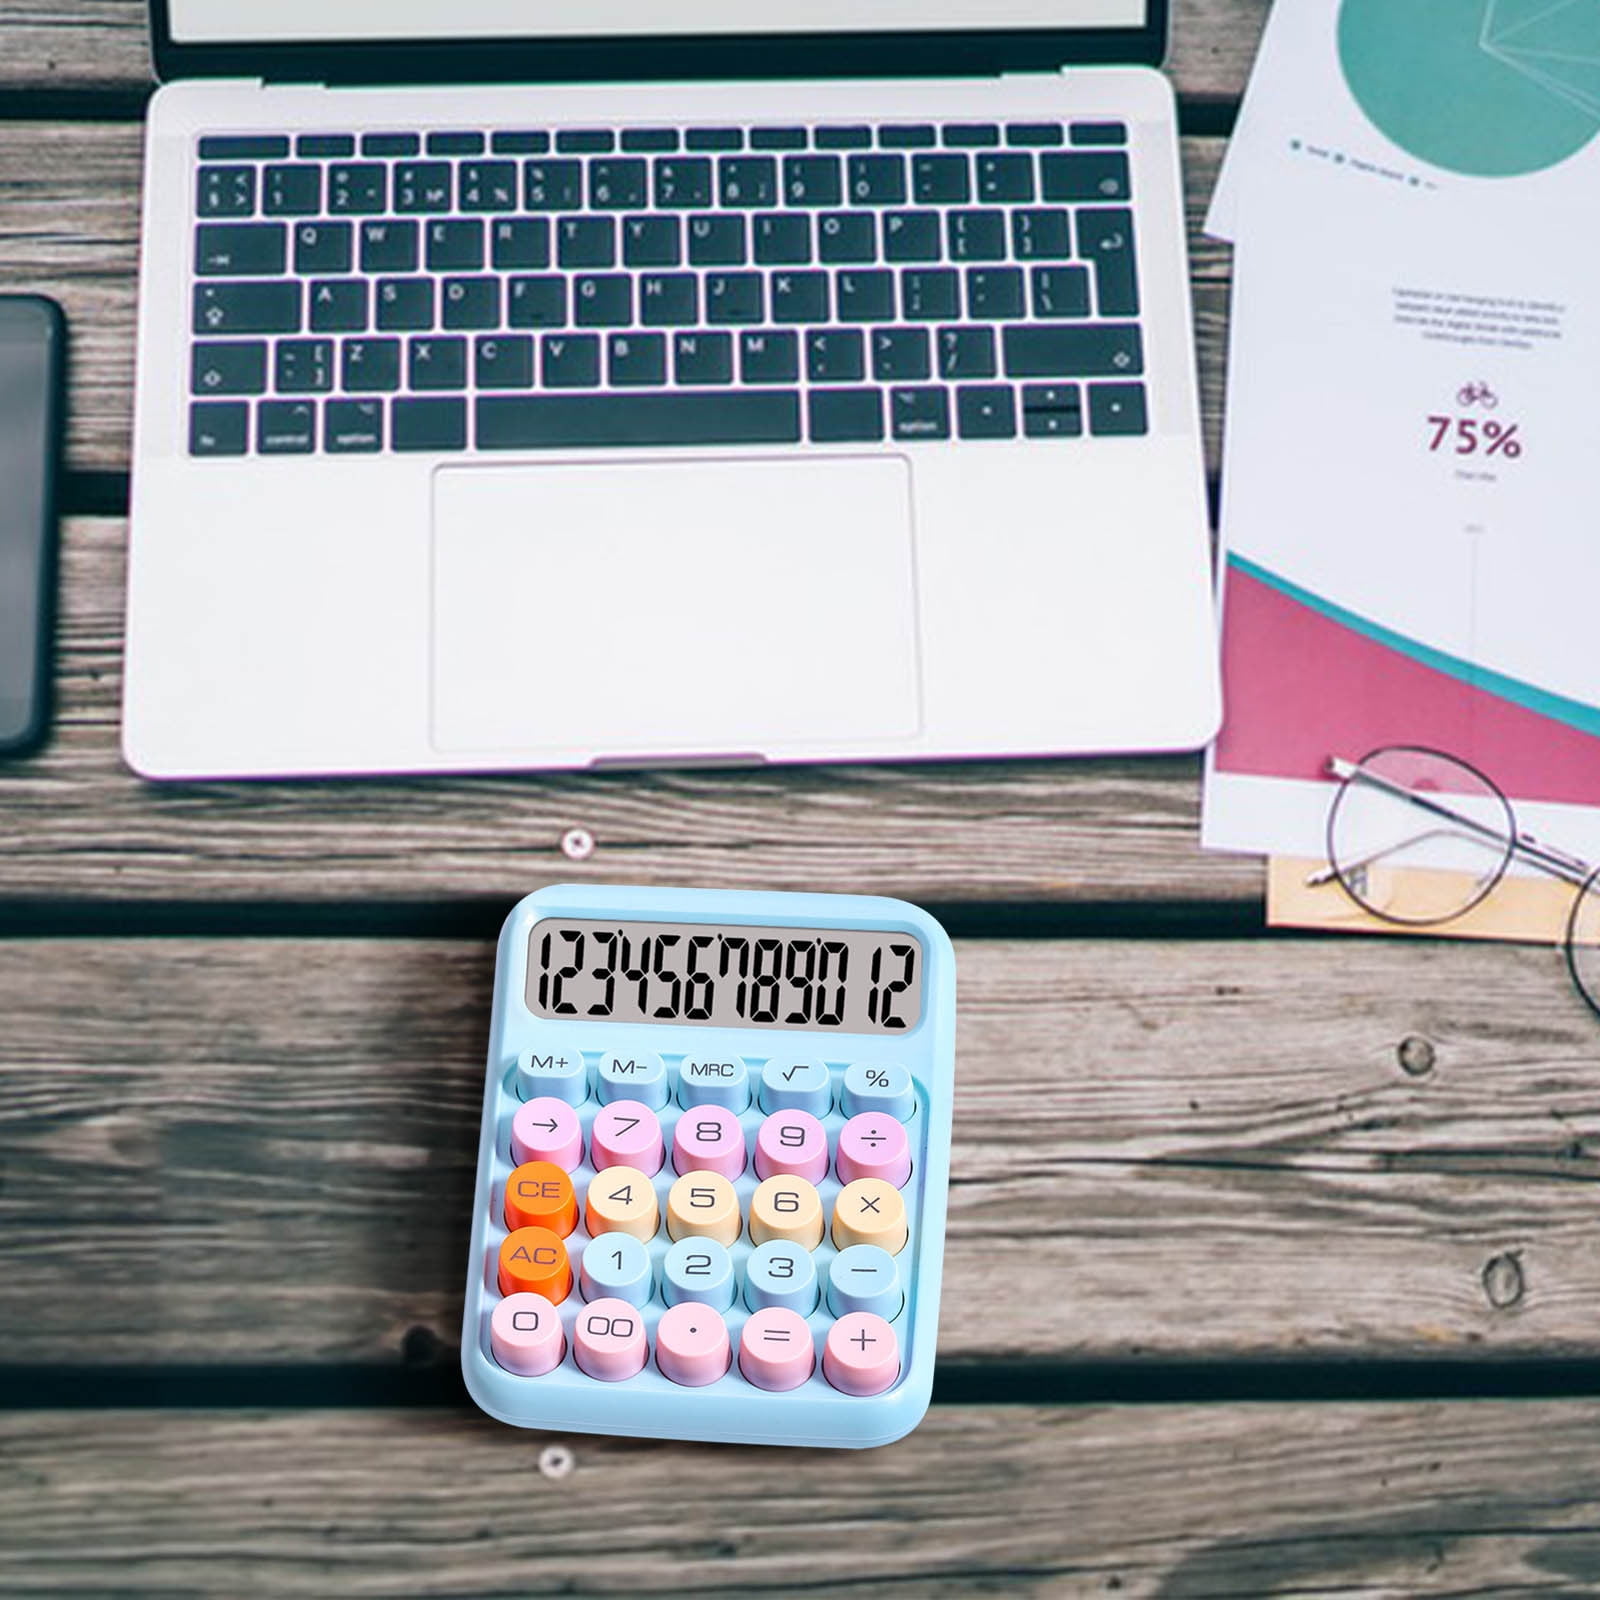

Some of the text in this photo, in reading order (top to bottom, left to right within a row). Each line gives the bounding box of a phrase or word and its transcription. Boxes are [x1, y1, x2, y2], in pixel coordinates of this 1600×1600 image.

[337, 189, 349, 206] 2
[467, 188, 479, 202] 4
[596, 185, 609, 201] 6
[664, 183, 674, 199] 7
[727, 183, 739, 198] 8
[791, 181, 805, 198] 9
[566, 222, 577, 238] T
[630, 222, 643, 236] Y
[693, 221, 710, 238] U
[889, 216, 903, 232] P
[301, 227, 317, 245] Q
[367, 227, 385, 241] W
[433, 225, 444, 241] E
[383, 285, 397, 301] S
[581, 280, 596, 298] G
[646, 281, 662, 294] H
[713, 278, 725, 296] J
[778, 278, 790, 292] K
[842, 276, 855, 293] L
[318, 286, 332, 301] A
[350, 344, 363, 361] Z
[417, 345, 429, 358] X
[481, 341, 497, 359] C
[549, 341, 564, 357] V
[614, 339, 629, 356] B
[680, 339, 696, 354] N
[747, 338, 764, 351] M
[1428, 416, 1520, 458] 75%
[530, 1054, 569, 1069] M+
[690, 1062, 735, 1077] MRC
[865, 1069, 889, 1088] %
[613, 1116, 641, 1137] 7
[695, 1121, 722, 1142] 8
[779, 1125, 806, 1148] 9
[517, 1180, 561, 1199] CE
[608, 1185, 633, 1206] 4
[689, 1187, 716, 1208] 5
[773, 1191, 800, 1213] 6
[509, 1245, 558, 1265] AC
[611, 1250, 622, 1271] 1
[685, 1254, 712, 1275] 2
[768, 1257, 794, 1279] 3
[763, 1329, 791, 1342] =
[849, 1328, 877, 1352] +
